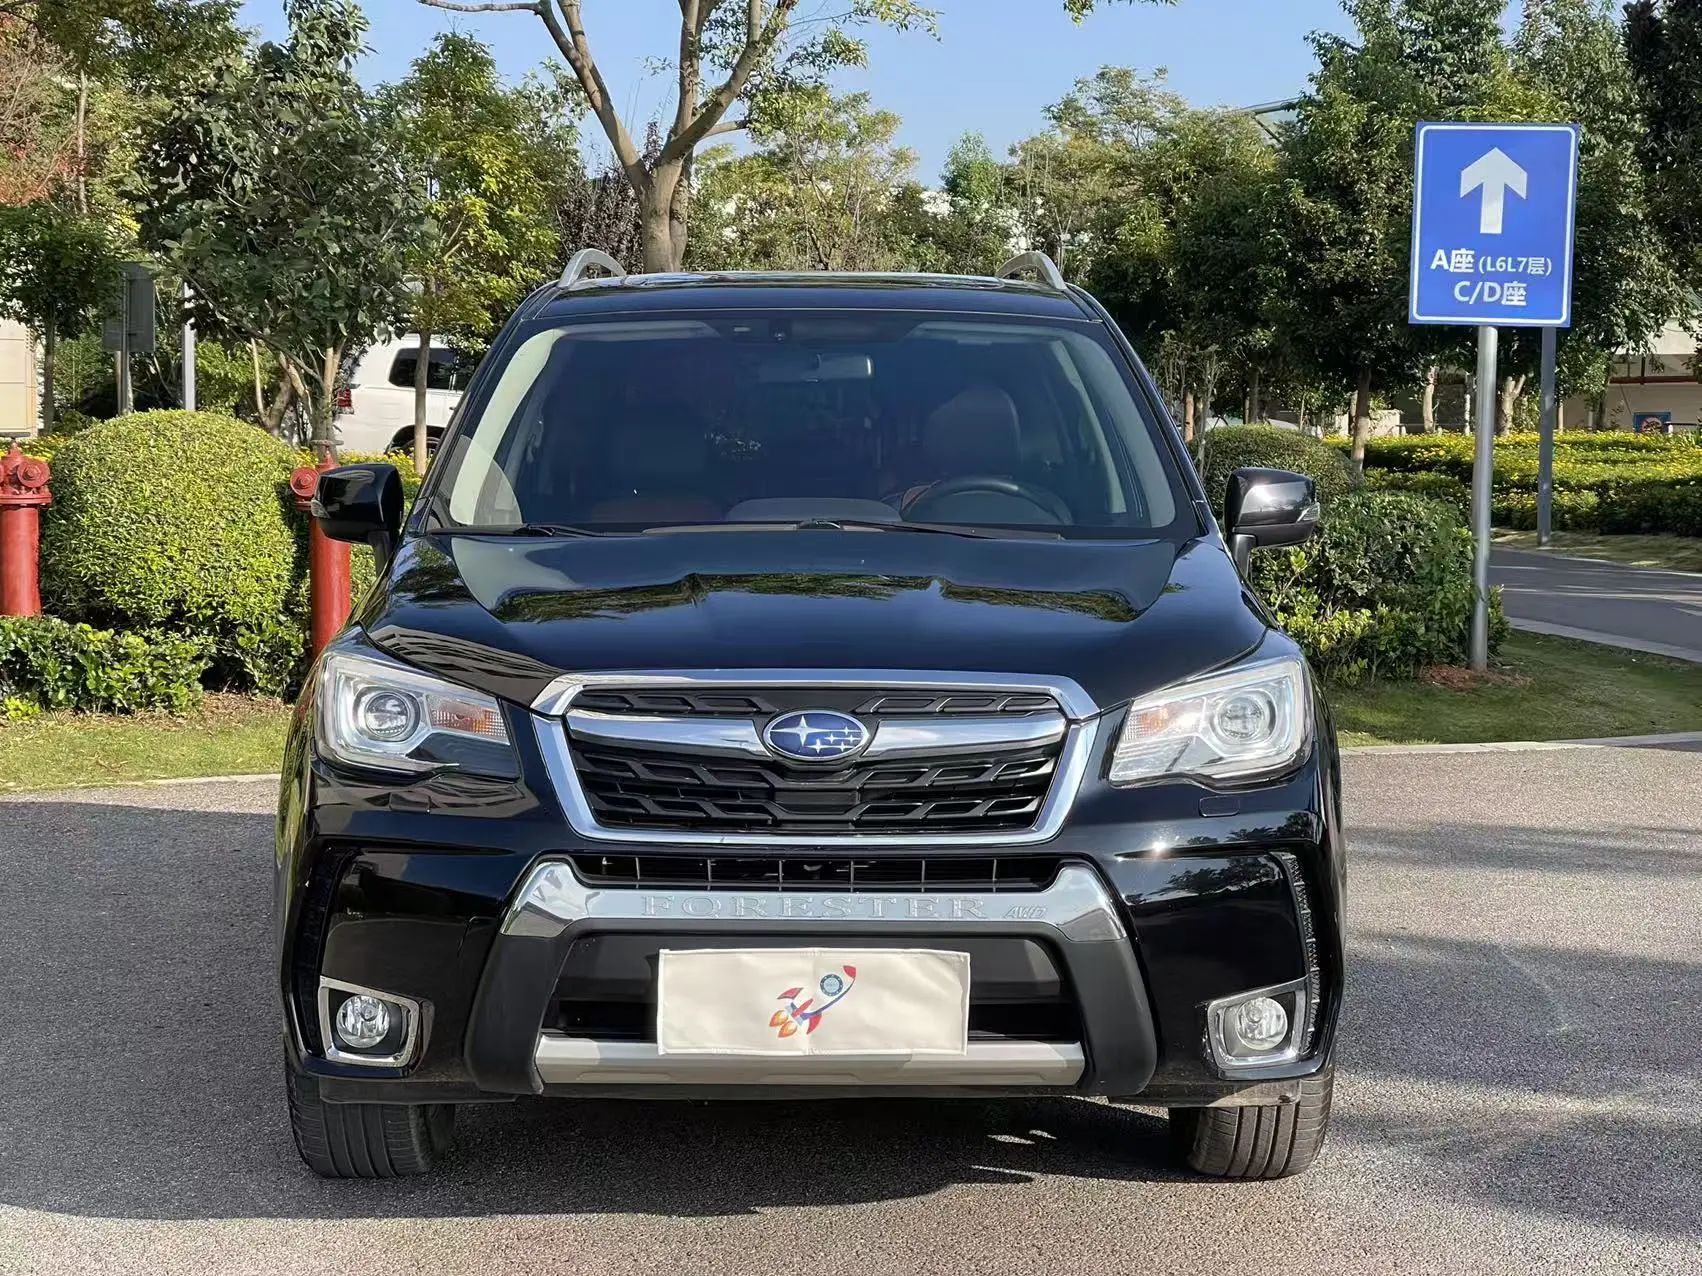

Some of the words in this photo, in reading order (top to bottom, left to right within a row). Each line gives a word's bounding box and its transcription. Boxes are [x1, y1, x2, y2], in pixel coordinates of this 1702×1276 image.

[1431, 248, 1475, 273] A座
[1479, 256, 1553, 276] (L6L7层)
[1454, 281, 1528, 306] C/D座
[642, 895, 989, 919] FORESTER
[1003, 905, 1047, 919] AWD
